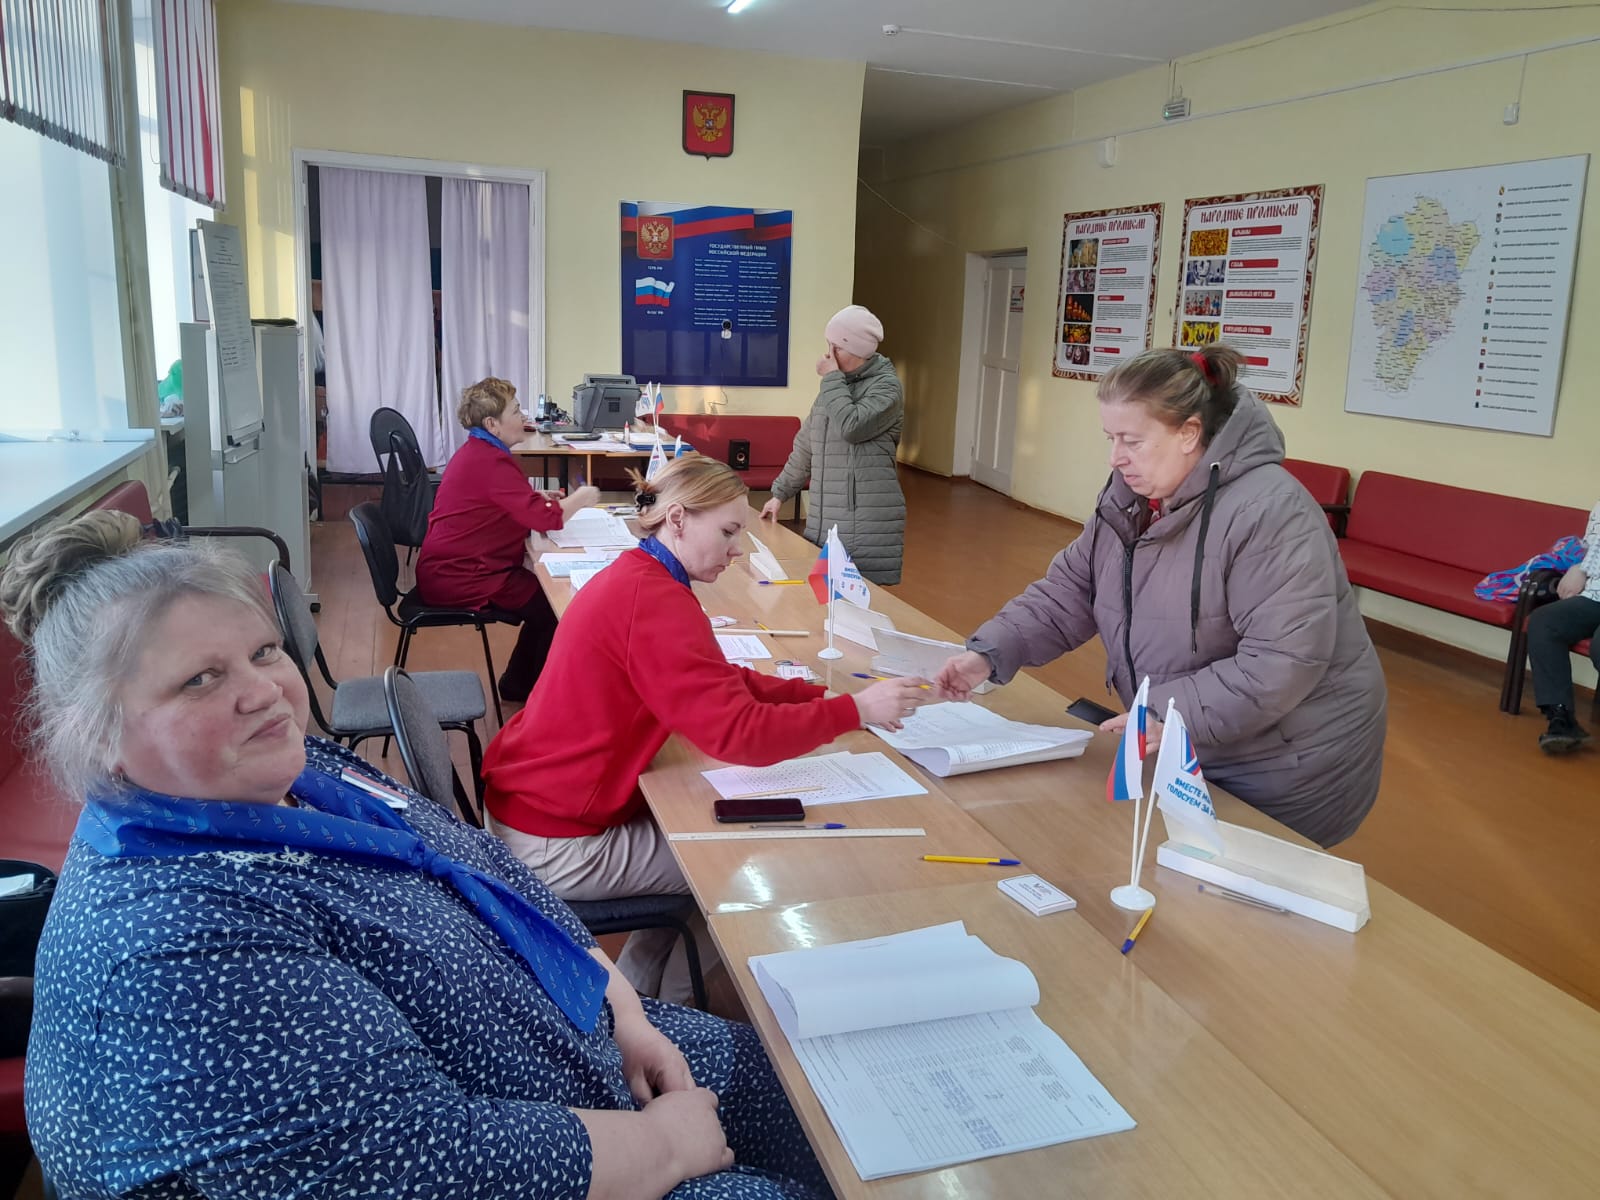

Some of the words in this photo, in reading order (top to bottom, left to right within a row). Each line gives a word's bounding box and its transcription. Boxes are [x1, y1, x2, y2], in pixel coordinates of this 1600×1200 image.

[1167, 783, 1201, 808] ГОЛОСУЕМ
[1201, 804, 1210, 814] ЗА
[1174, 777, 1202, 798] ВМЕСТЕ
